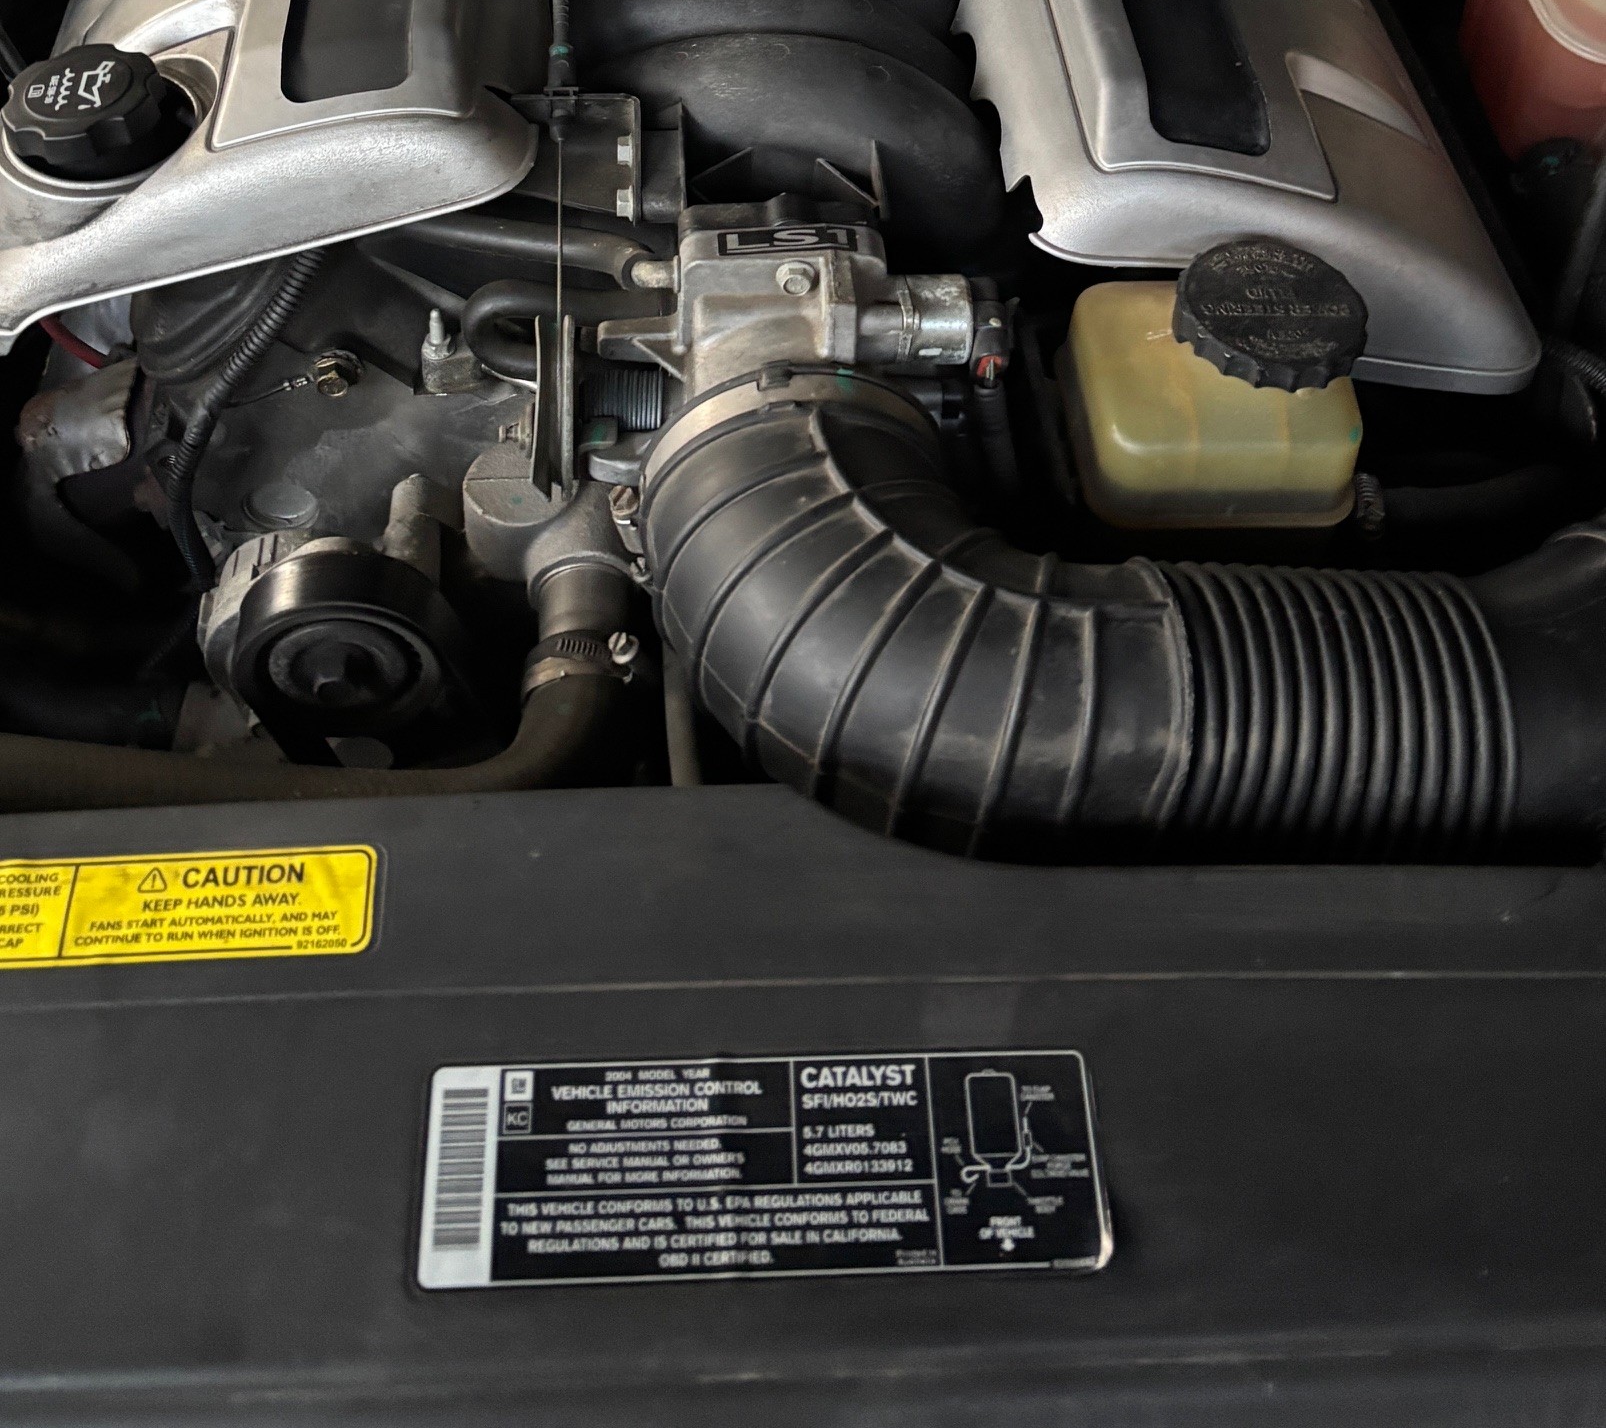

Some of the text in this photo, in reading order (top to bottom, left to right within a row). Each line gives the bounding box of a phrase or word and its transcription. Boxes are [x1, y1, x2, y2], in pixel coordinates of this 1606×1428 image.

[726, 228, 848, 249] LS1
[182, 862, 306, 889] CAUTION
[0, 886, 62, 898] RESSURE
[9, 903, 39, 918] PSI)
[142, 899, 183, 913] KEEP
[186, 894, 247, 909] HANDS
[89, 911, 338, 932] FANS START AUTOMATICALLY, AND MAY
[74, 932, 142, 947] CONTINUE
[144, 932, 164, 942] TO
[166, 930, 195, 942] RUN
[197, 929, 236, 940] WHEN
[239, 926, 299, 938] IGNITION
[302, 926, 313, 936] IS
[638, 1069, 676, 1080] MODEL
[682, 1068, 710, 1079] YEAR
[800, 1064, 916, 1088] CATALYST
[551, 1081, 762, 1100] VEHICLE EMISSION CONTROL
[801, 1090, 918, 1109] SFI/HO2S/TWC
[606, 1098, 708, 1114] INFORMATION
[507, 1111, 529, 1125] KC
[567, 1115, 747, 1132] GENERAL MOTORS CORPORATION
[827, 1123, 875, 1138] LITERS
[568, 1142, 586, 1153] NO
[590, 1140, 670, 1153] ADJUSTMENTS
[546, 1158, 568, 1170] SEE
[572, 1156, 619, 1169] SERVICE
[623, 1155, 669, 1168] MANUAL
[673, 1154, 689, 1166] OR
[547, 1173, 594, 1185] MANUAL
[597, 1172, 621, 1183] FOR
[625, 1170, 659, 1183] MORE
[507, 1202, 538, 1217] THIS
[541, 1201, 595, 1215] VEHICLE
[598, 1199, 673, 1214] CONFORMS
[676, 1198, 693, 1211] TO
[726, 1196, 751, 1209] EPA
[753, 1192, 843, 1208] REGULATIONS
[846, 1190, 922, 1205] APPLICABLE
[500, 1222, 518, 1236] TO
[521, 1221, 552, 1235] NEW
[556, 1218, 635, 1234] PASSENGER
[685, 1215, 715, 1229] THIS
[718, 1213, 771, 1228] VEHICLE
[774, 1211, 849, 1226] CONFORMS
[852, 1210, 869, 1223] TO
[872, 1208, 930, 1223] FEDERAL
[527, 1237, 619, 1253] REGULATIONS
[623, 1236, 650, 1250] AND
[654, 1235, 667, 1249] IS
[670, 1232, 737, 1248] CERTIFIED
[741, 1232, 767, 1245] FOR
[771, 1230, 802, 1244] SALE
[806, 1230, 820, 1243] IN
[658, 1253, 688, 1267] OBD
